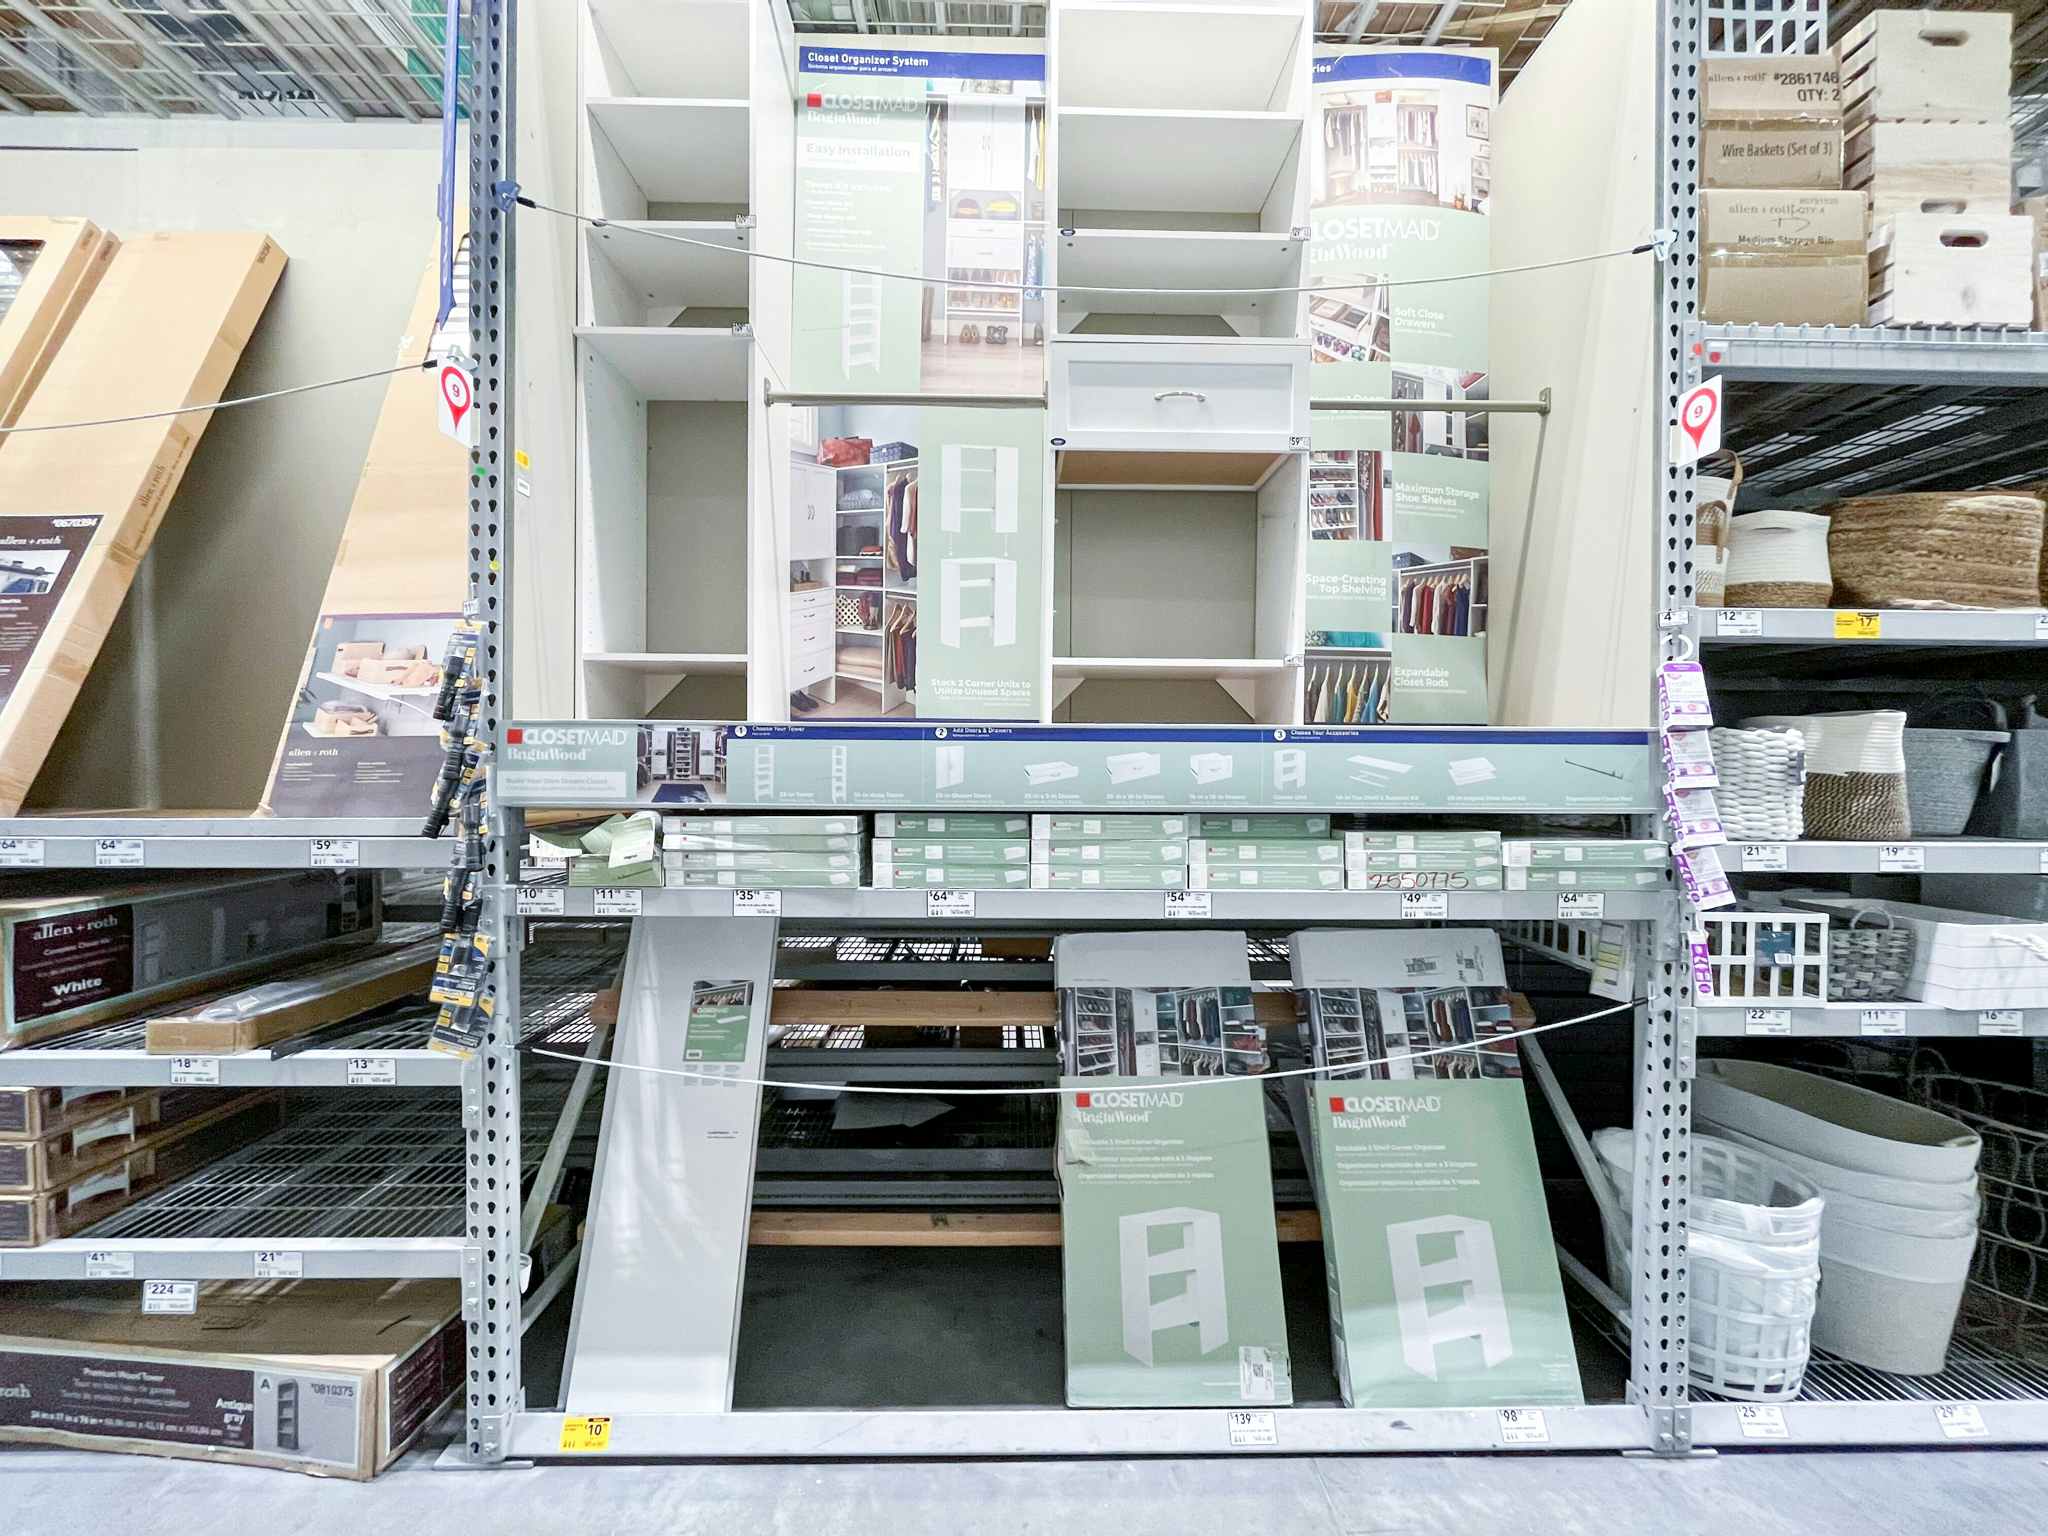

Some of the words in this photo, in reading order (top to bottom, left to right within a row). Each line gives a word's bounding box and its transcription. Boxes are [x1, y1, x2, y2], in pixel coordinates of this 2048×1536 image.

[808, 52, 839, 63] Closet
[841, 53, 890, 66] Organizer
[892, 56, 929, 67] System
[1797, 88, 1828, 102] QTY:
[1831, 88, 1841, 101] 2
[807, 143, 836, 157] Easy
[1722, 144, 1745, 157] Wire
[1747, 144, 1785, 157] Baskets
[1787, 142, 1808, 157] (Set
[1809, 142, 1820, 155] of
[1822, 141, 1833, 156] 3)
[1394, 308, 1416, 318] Soft
[1417, 308, 1445, 320] Close
[452, 383, 461, 398] 9
[1694, 404, 1704, 418] 9
[1394, 491, 1421, 503] Shoe
[1319, 583, 1341, 594] Top
[1342, 584, 1387, 596] Shelving
[523, 728, 626, 746] CLOSETMAID
[32, 923, 74, 941] allen
[87, 917, 118, 931] roth
[51, 977, 103, 996] White
[1090, 1092, 1184, 1108] CLOSETMAID
[1344, 1095, 1440, 1113] CLOSETMAID
[1332, 1115, 1408, 1130] BrightWood
[260, 1379, 270, 1390] A
[215, 1398, 254, 1413] Antique
[223, 1413, 245, 1425] gray
